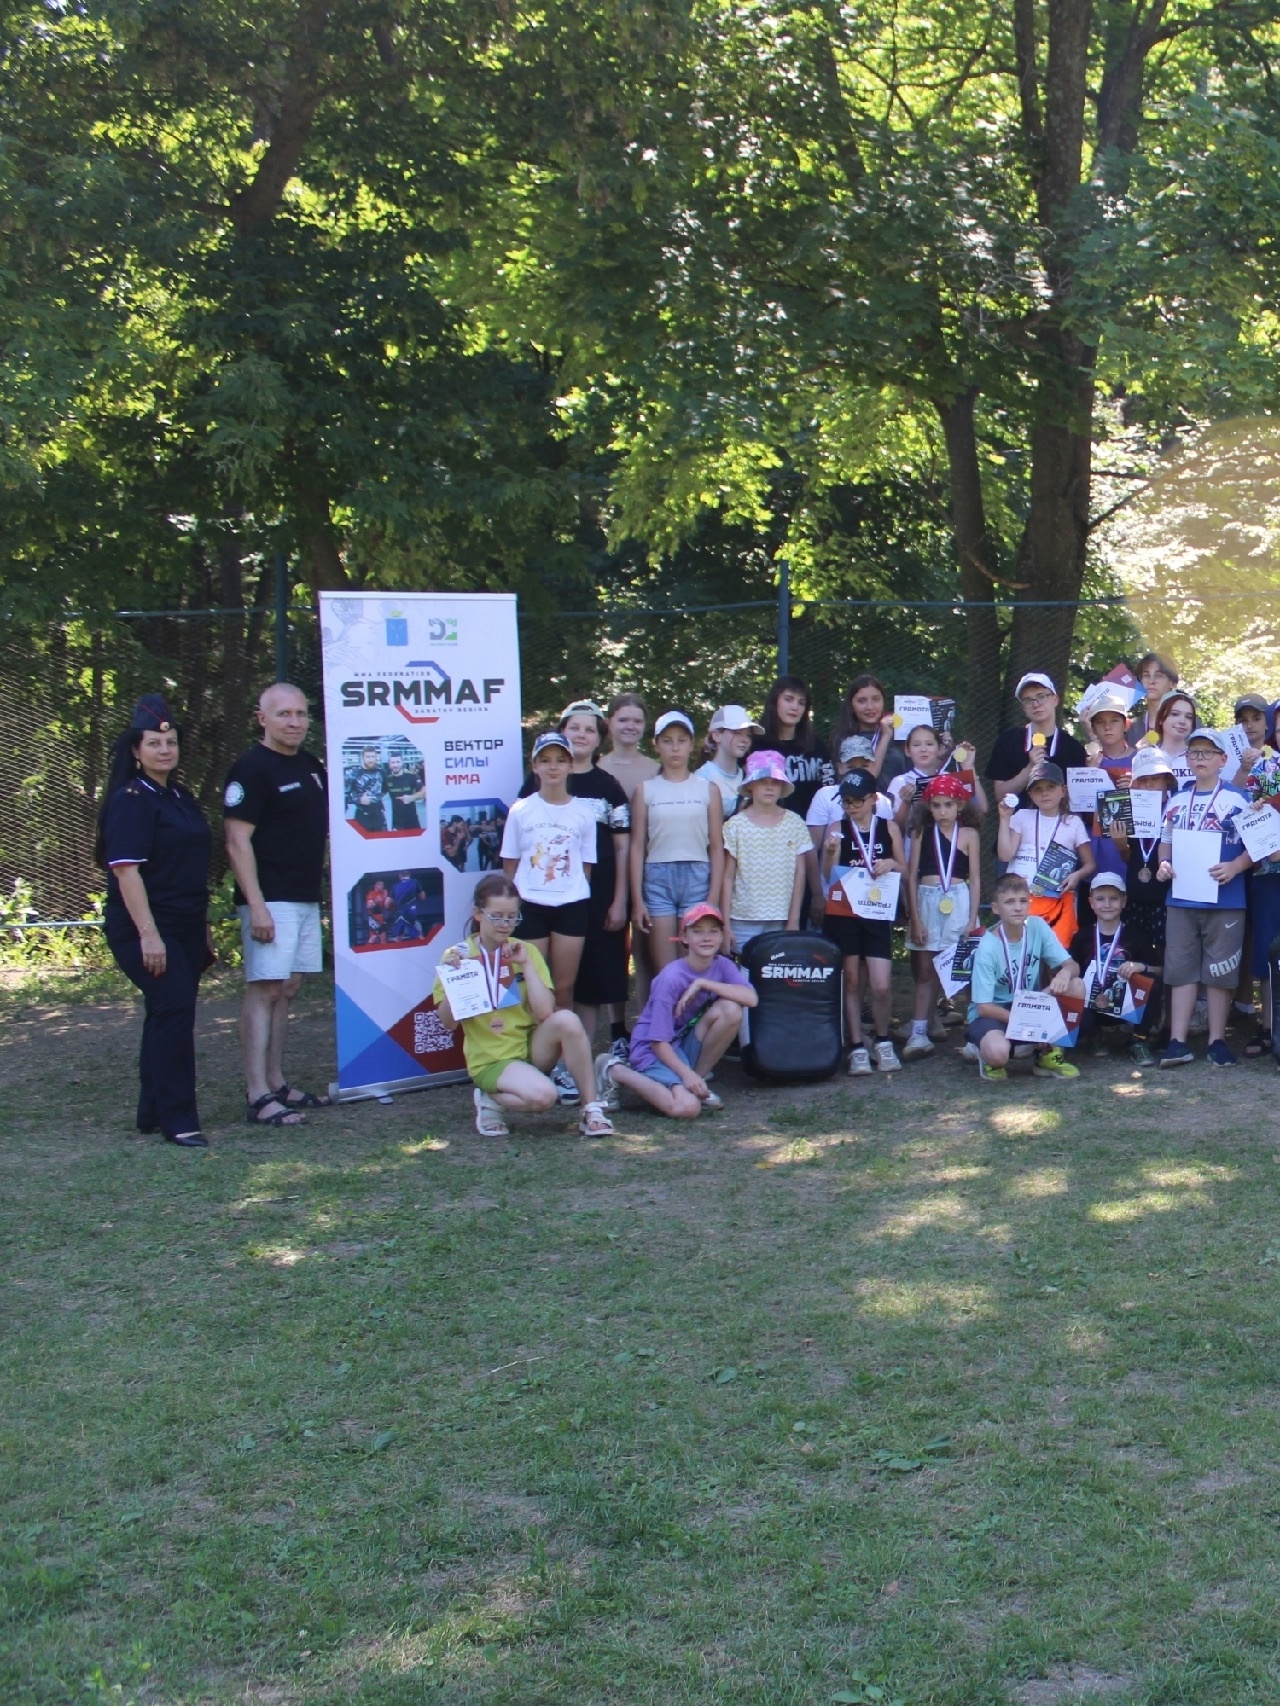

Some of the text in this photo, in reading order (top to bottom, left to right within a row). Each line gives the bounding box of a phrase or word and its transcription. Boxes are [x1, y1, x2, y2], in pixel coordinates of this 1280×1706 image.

[340, 678, 505, 707] SRMMAF
[444, 739, 504, 751] ВЕКТОР
[444, 756, 489, 768] СИЛЫ
[1241, 812, 1273, 831] ГРАМОТА
[446, 971, 479, 984] ГРАМОТА
[761, 966, 834, 979] SRMMAF
[1017, 1002, 1051, 1012] ГРАМОТА
